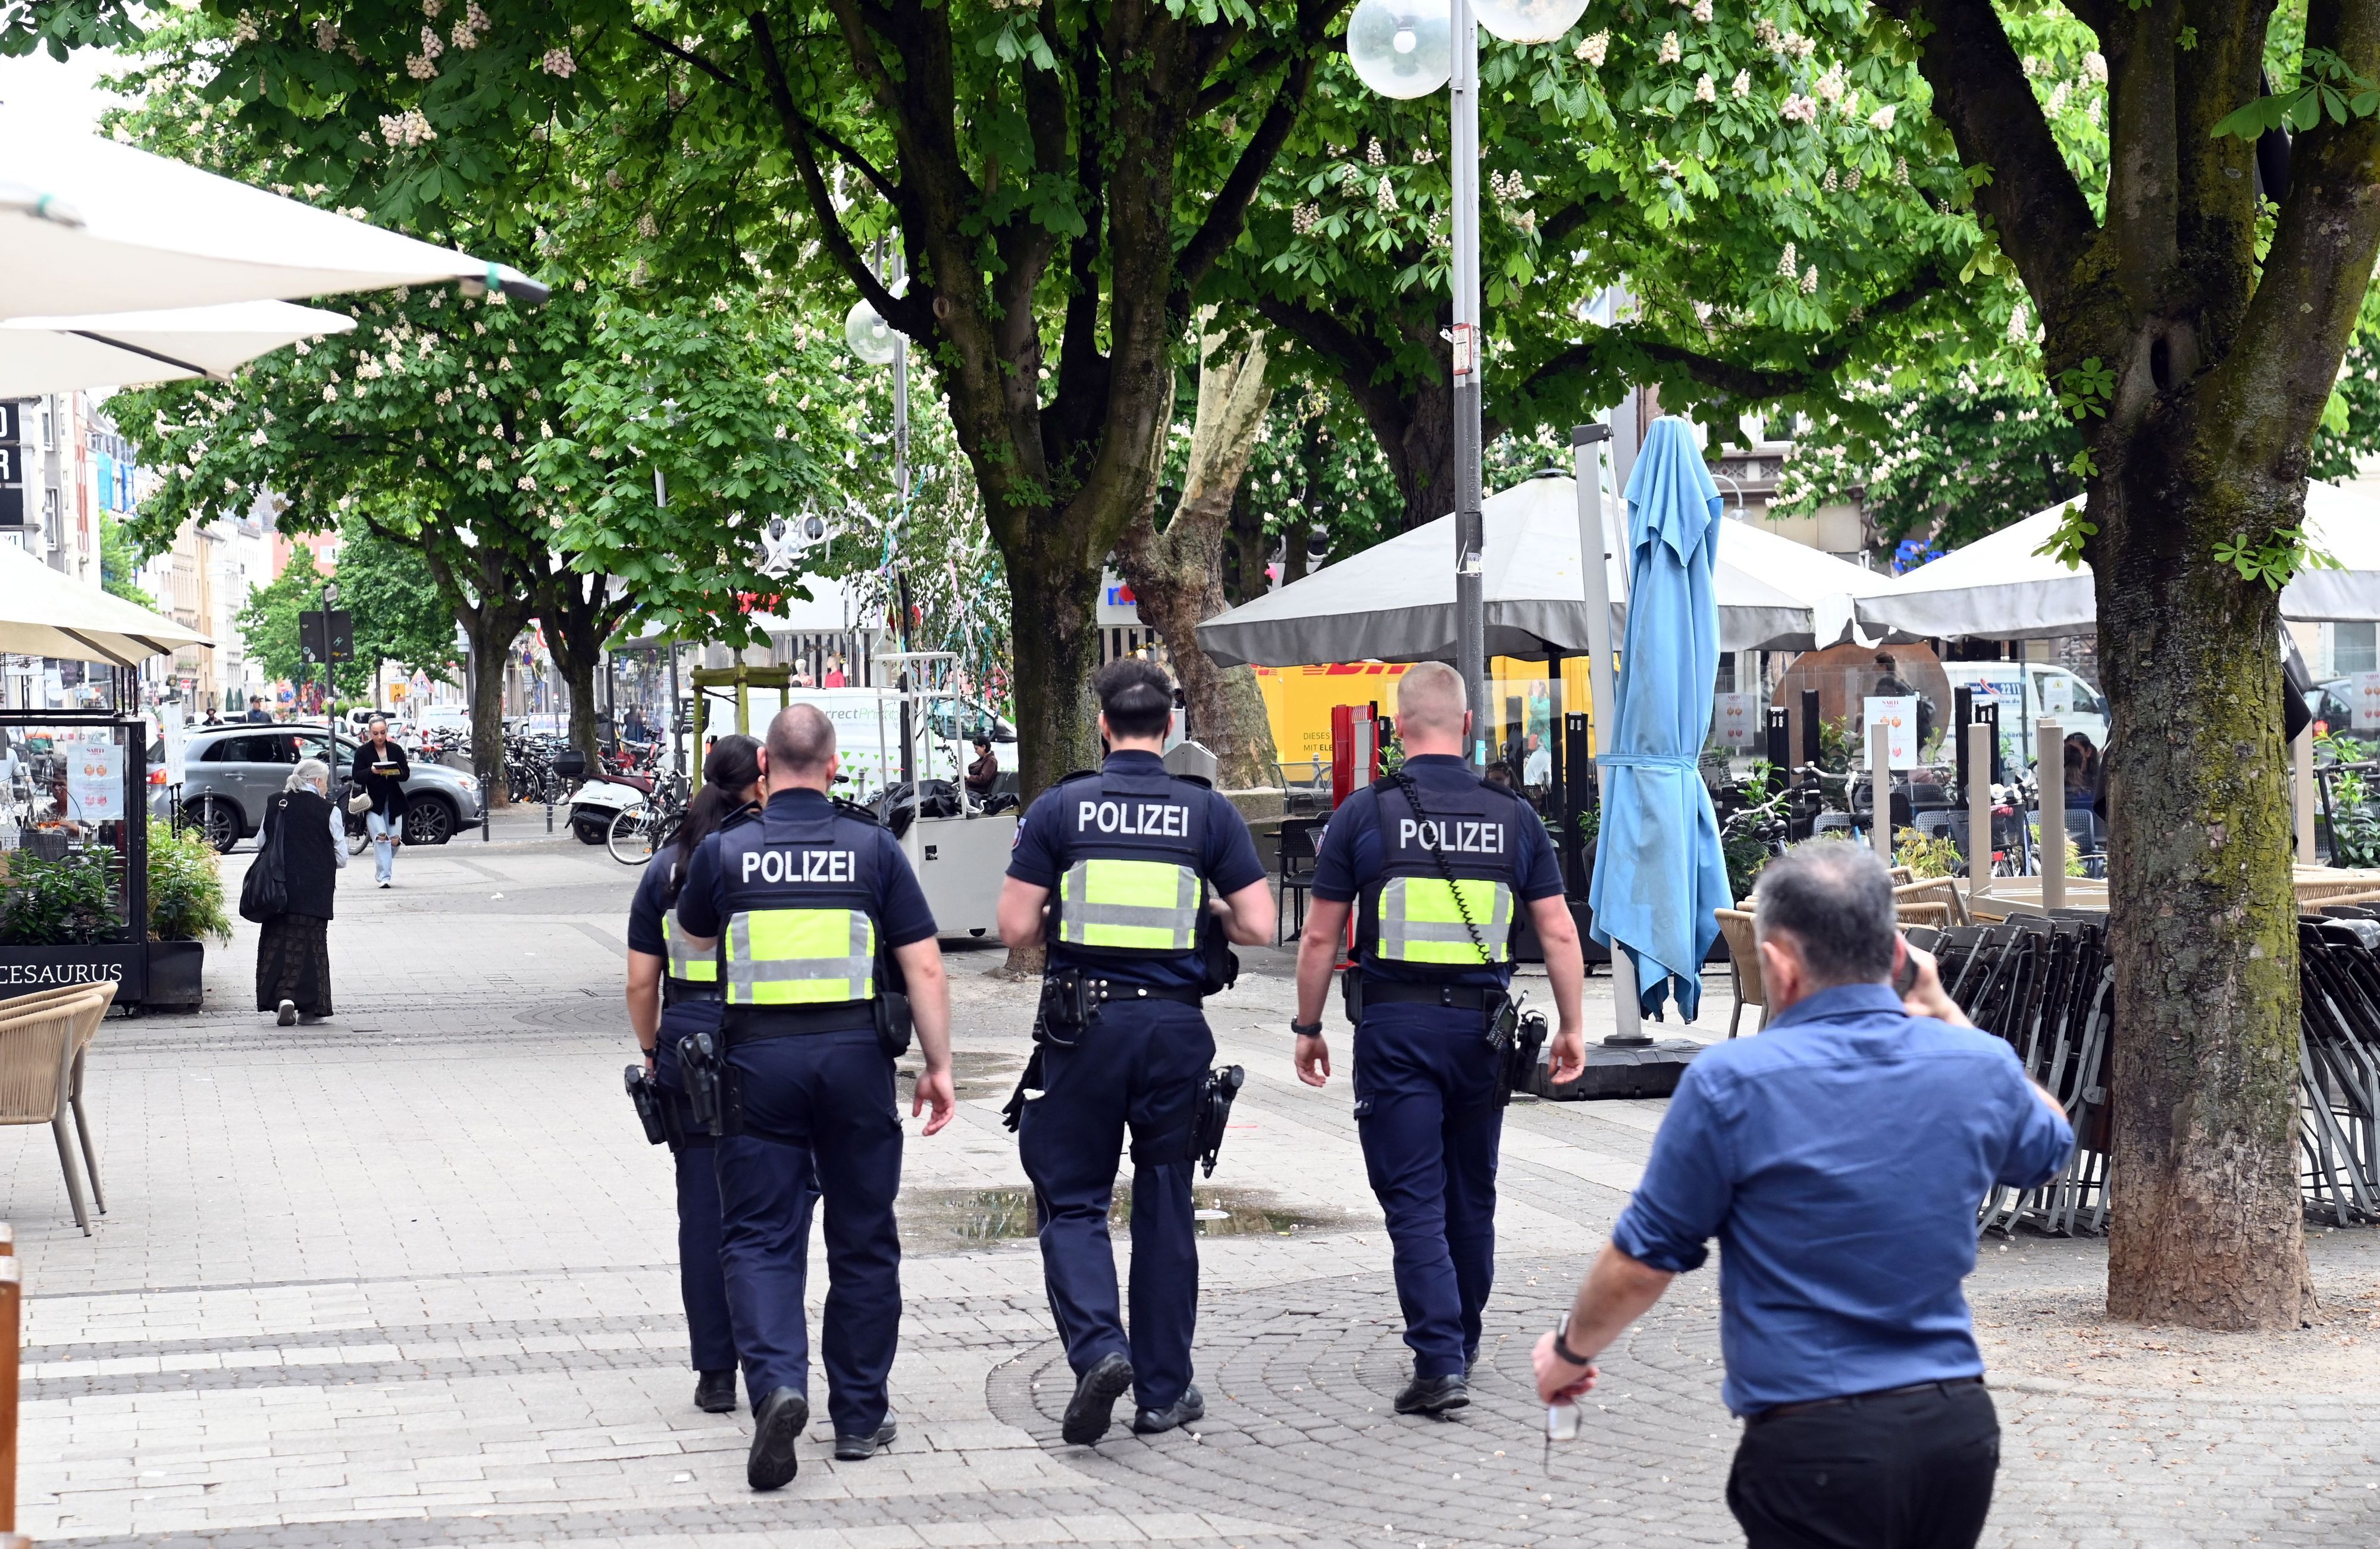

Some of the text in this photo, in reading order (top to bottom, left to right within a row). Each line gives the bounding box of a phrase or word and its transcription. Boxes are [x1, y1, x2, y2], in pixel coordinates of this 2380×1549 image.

[1078, 801, 1189, 837] POLIZEI
[1400, 819, 1504, 854] POLIZEI
[742, 850, 855, 883] POLIZEI
